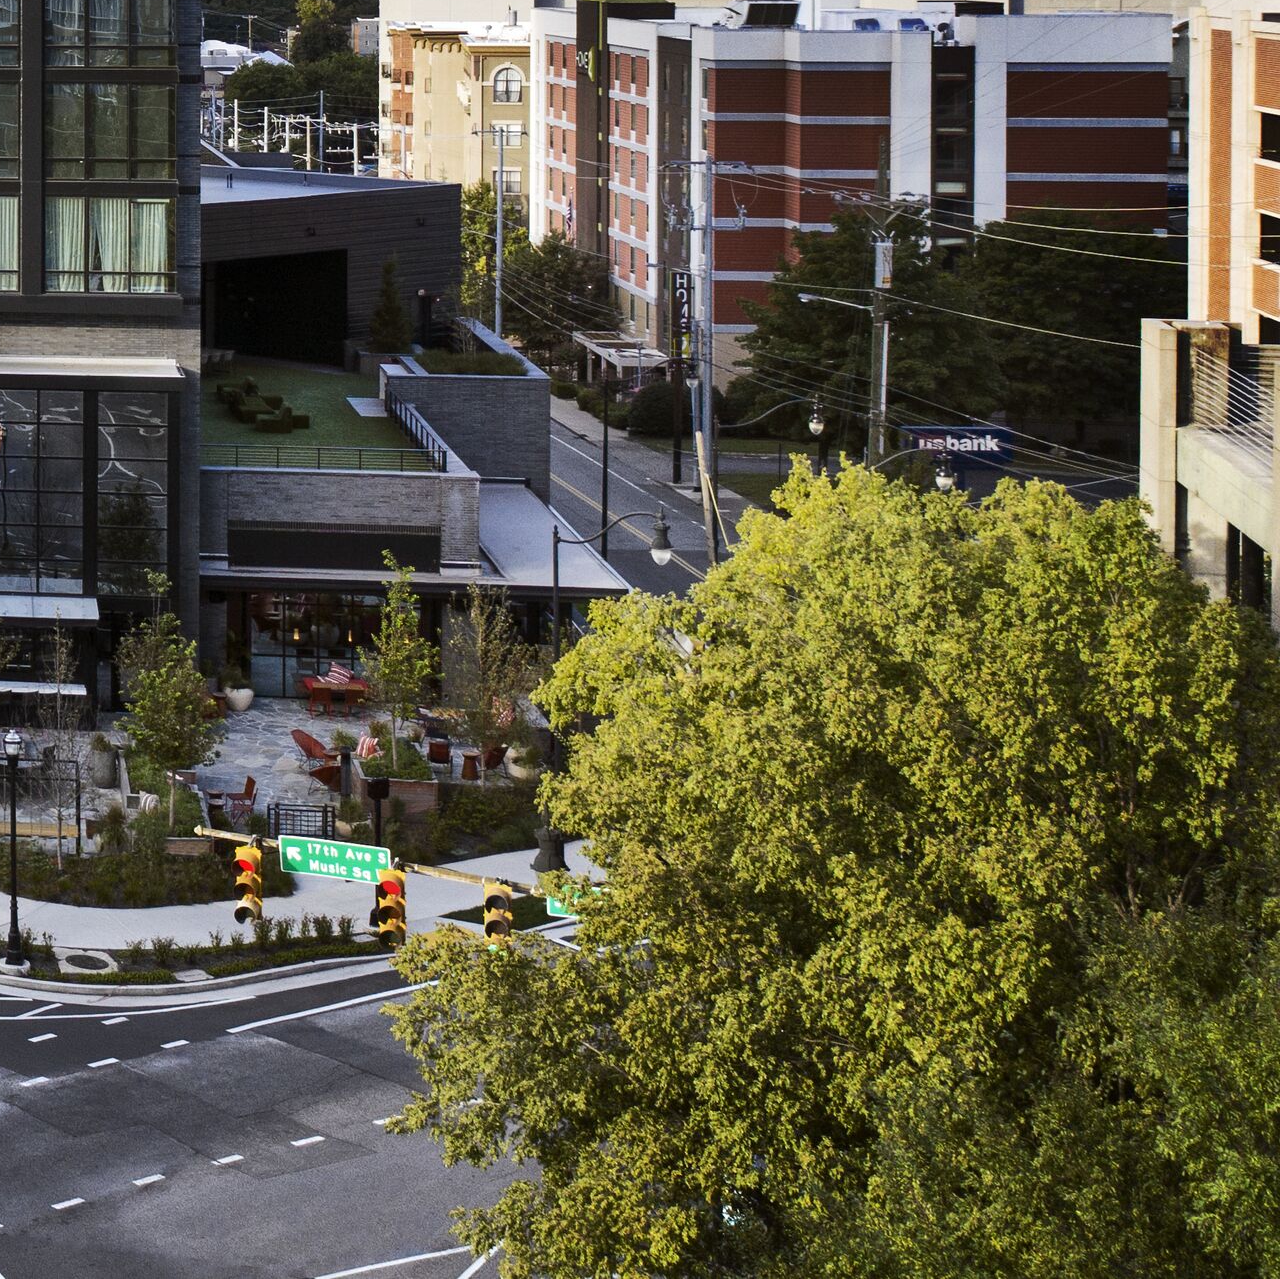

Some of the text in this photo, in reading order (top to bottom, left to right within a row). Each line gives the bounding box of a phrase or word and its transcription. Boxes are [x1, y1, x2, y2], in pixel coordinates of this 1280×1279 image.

[307, 842, 387, 864] 17th Ave S
[308, 859, 348, 876] Music
[351, 867, 371, 881] Sq
